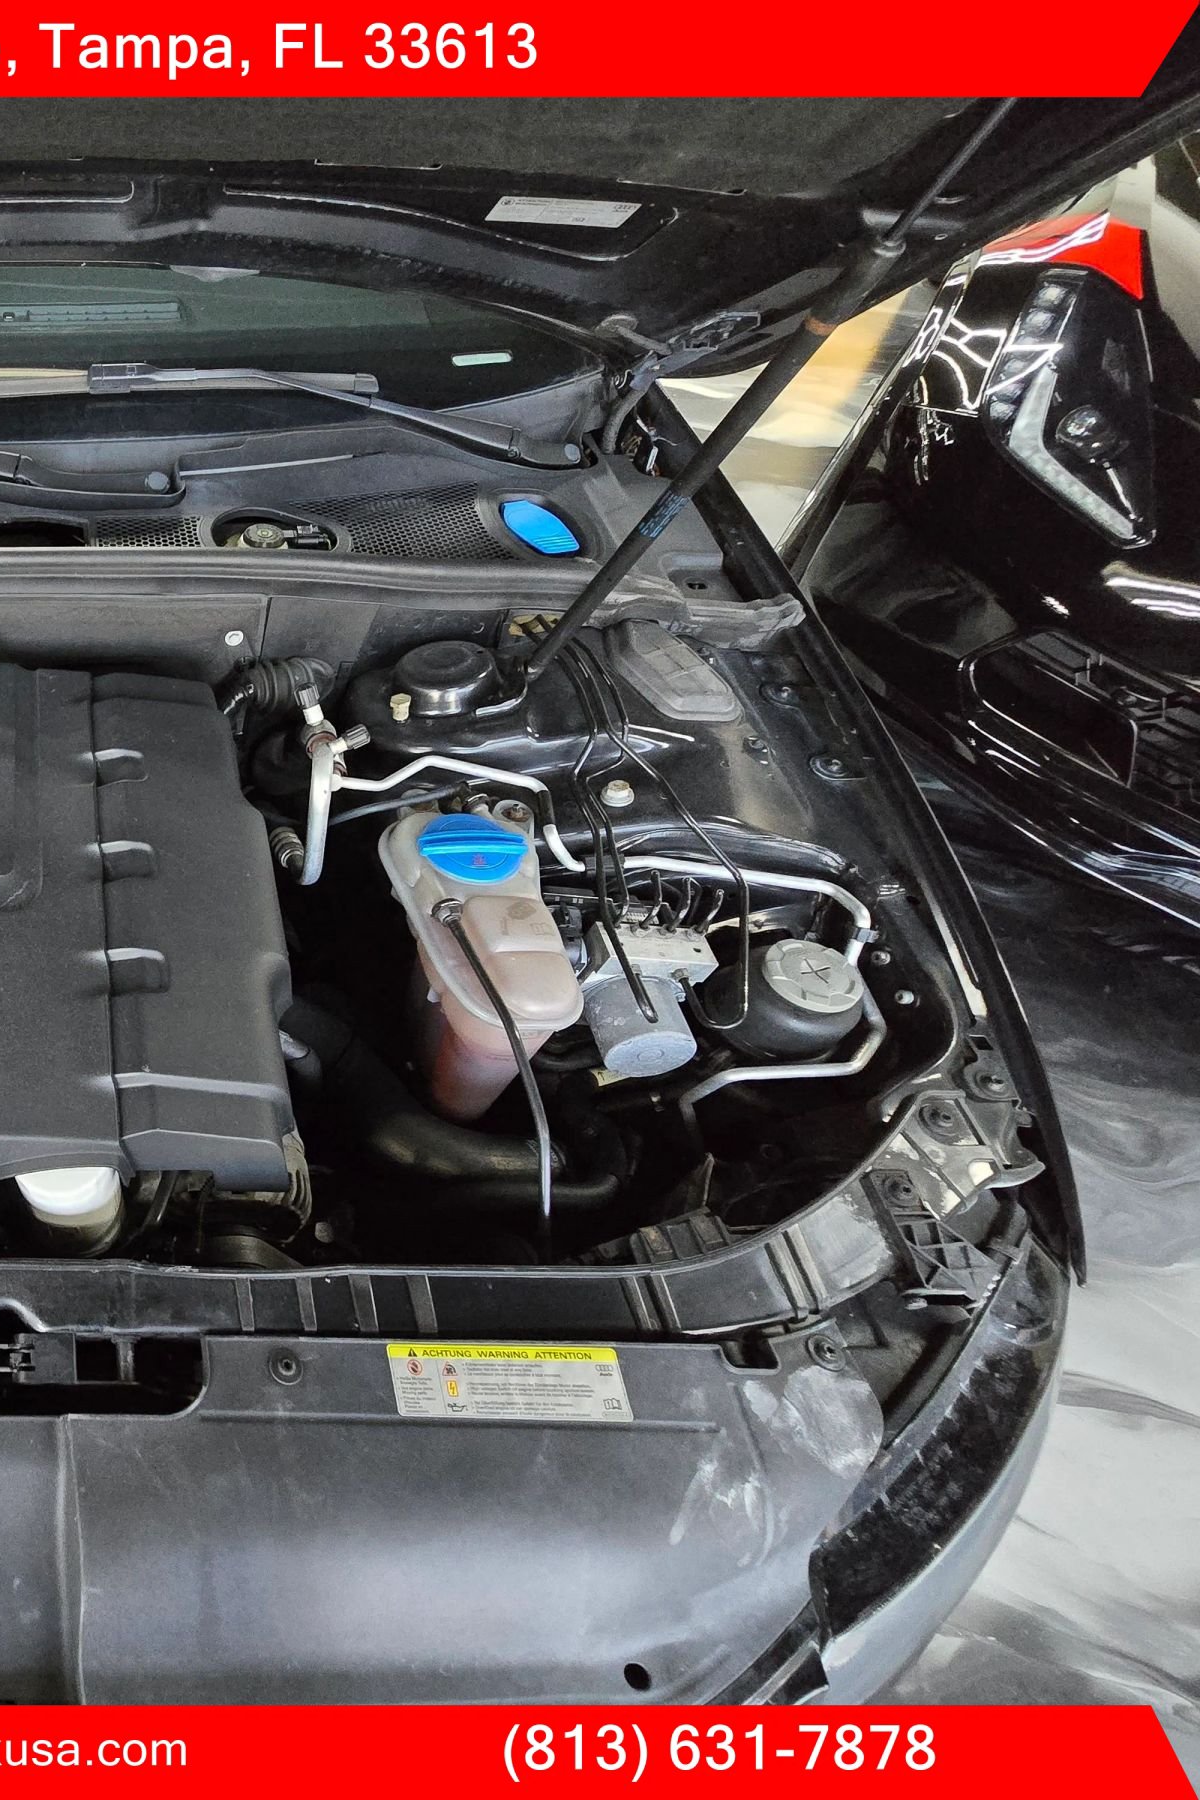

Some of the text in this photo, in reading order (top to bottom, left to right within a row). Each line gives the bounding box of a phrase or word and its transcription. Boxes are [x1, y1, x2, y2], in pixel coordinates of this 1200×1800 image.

[421, 1349, 592, 1361] ACHTUNG WARNING ATTENTION
